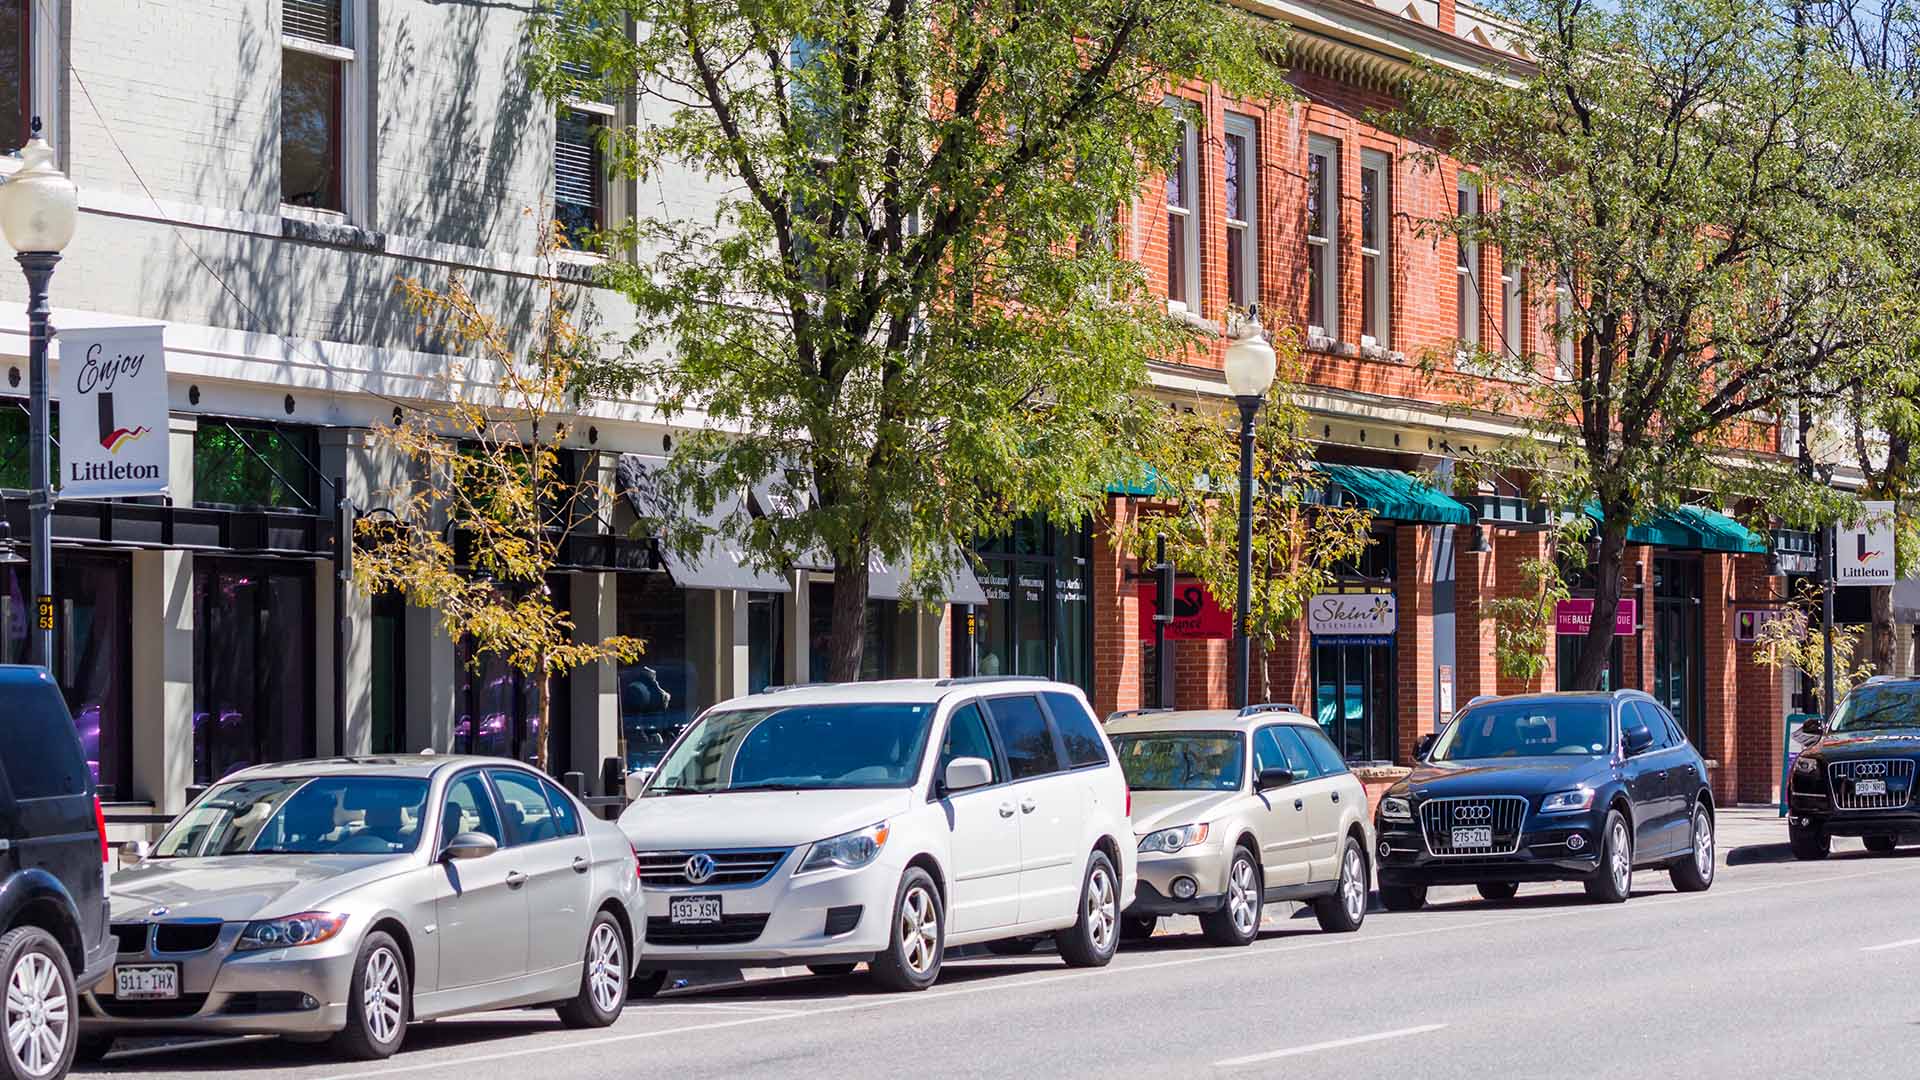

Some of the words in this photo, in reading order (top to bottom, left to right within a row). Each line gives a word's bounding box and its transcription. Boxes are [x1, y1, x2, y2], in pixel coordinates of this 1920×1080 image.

[77, 343, 144, 394] Enjoy
[71, 461, 159, 481] Littleton
[1843, 567, 1889, 577] Littleton
[40, 604, 53, 616] 91
[1313, 599, 1372, 622] Skin
[40, 616, 53, 629] 53
[1559, 616, 1571, 625] THE
